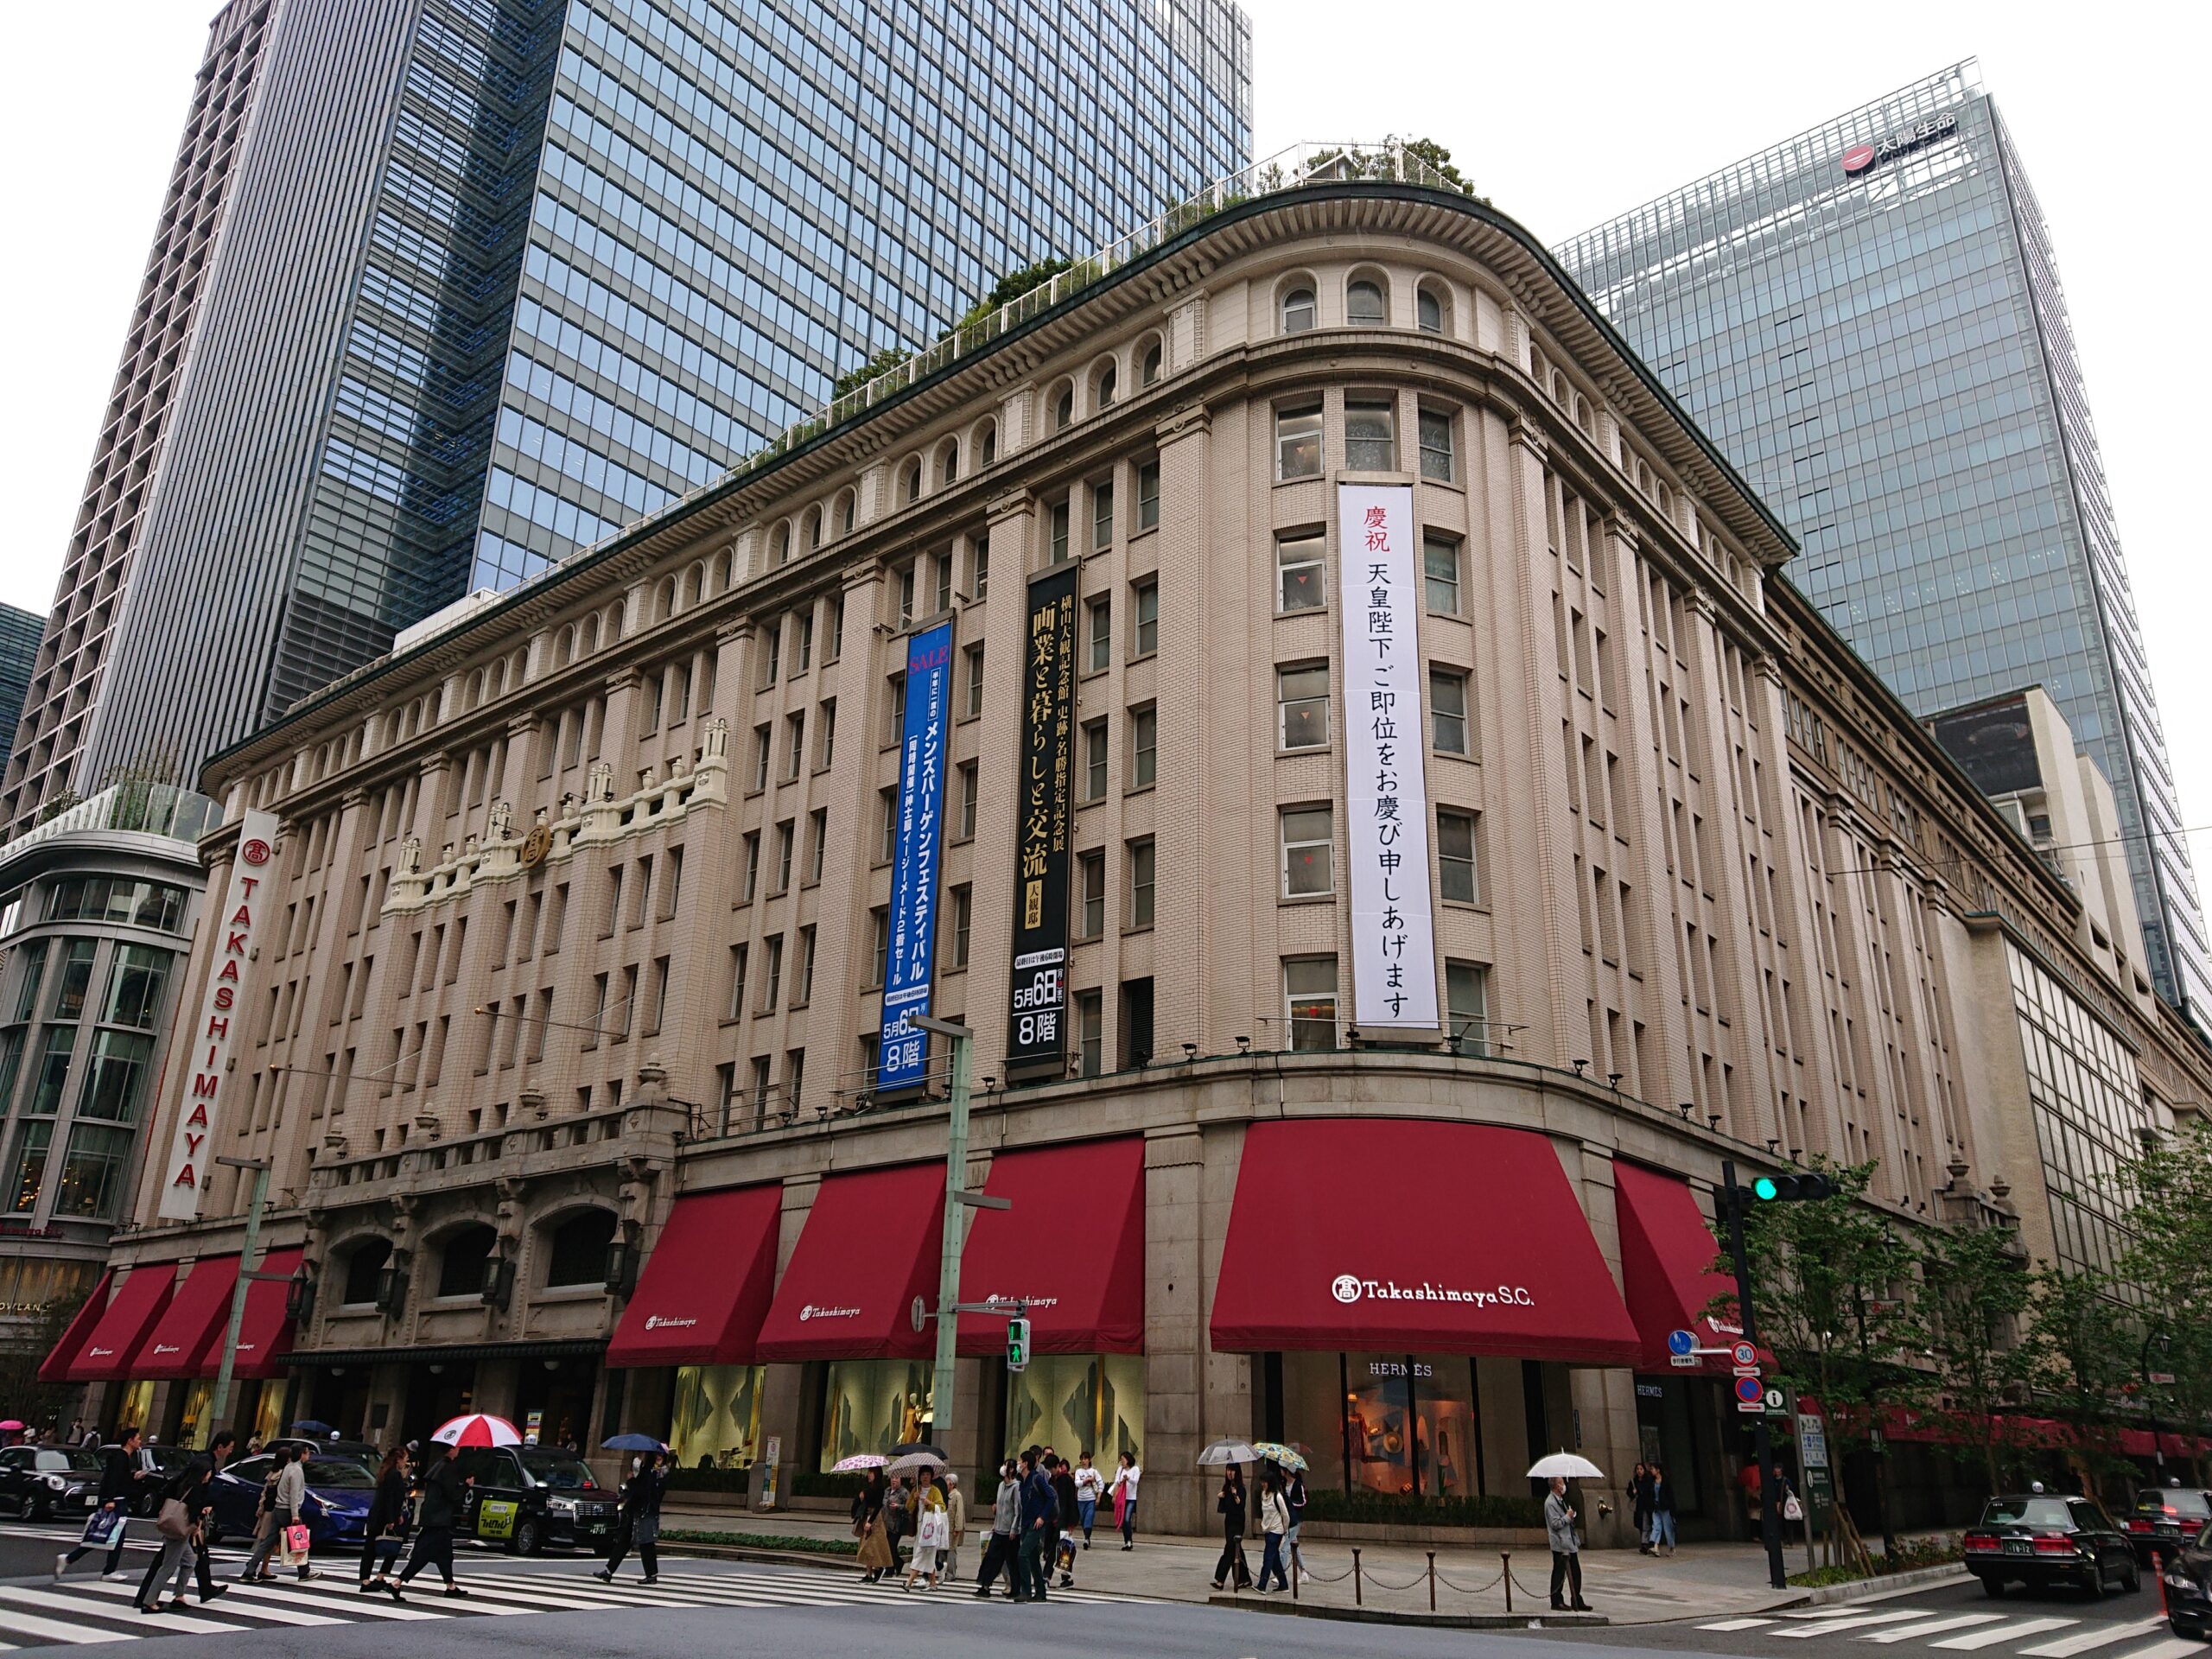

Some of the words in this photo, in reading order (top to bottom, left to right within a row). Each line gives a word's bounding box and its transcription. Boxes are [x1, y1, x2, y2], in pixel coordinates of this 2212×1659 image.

[1876, 112, 1956, 157] 太陽生命
[1363, 505, 1391, 553] 慶祝
[909, 645, 950, 675] SALE
[1057, 594, 1072, 700] 横山大観記念館
[1023, 601, 1057, 880] 画業と暮らしと交流
[1366, 563, 1409, 1020] 天皇陛下ご即位をお慶び申しあげます
[910, 721, 939, 982] メンズバーゲンフェスティバル
[1027, 883, 1039, 926] 大観邸
[1014, 969, 1057, 1009] 5月6日
[174, 876, 258, 1188] TAKASHIMAYA
[1019, 1013, 1056, 1046] 8階
[886, 1039, 919, 1072] 8階
[811, 1306, 861, 1319] Takashimaya
[1363, 1280, 1498, 1308] Takashimaya
[1497, 1286, 1535, 1306] S.C.
[1737, 1348, 1753, 1361] 30
